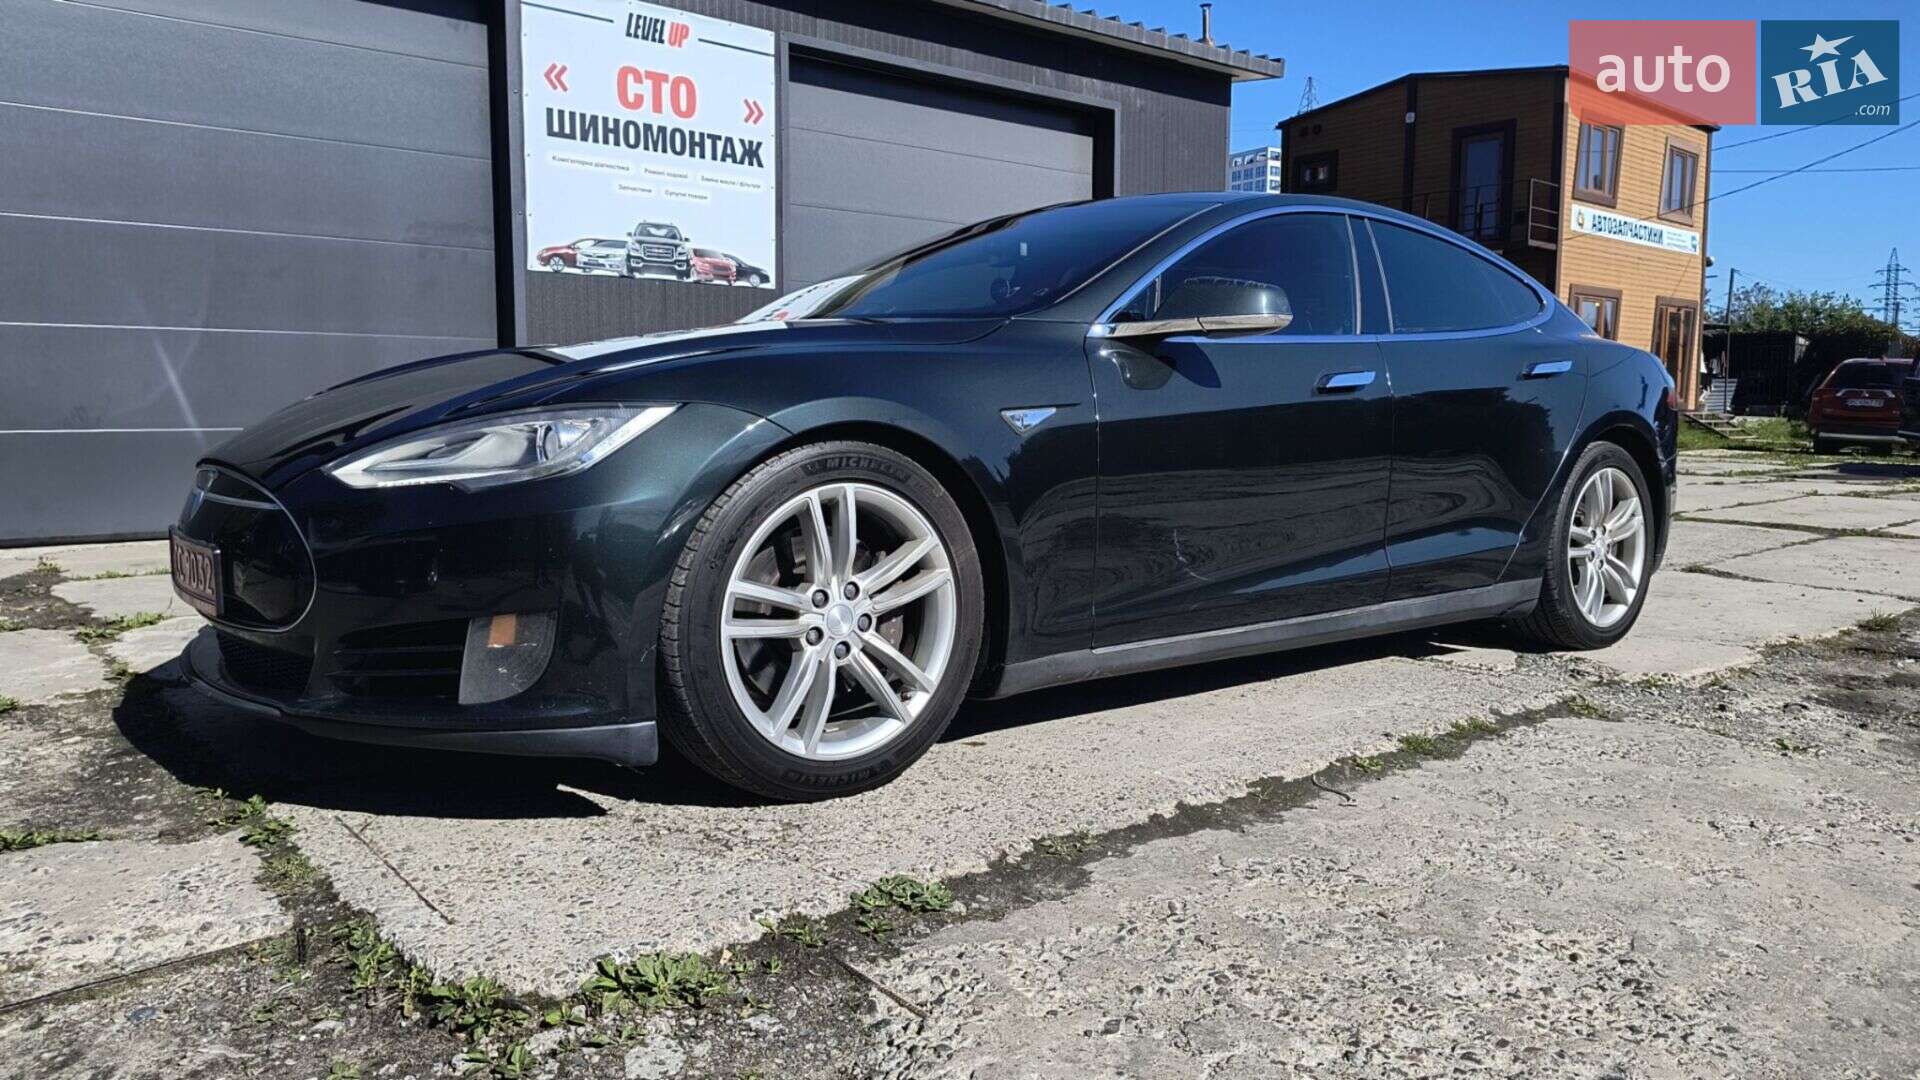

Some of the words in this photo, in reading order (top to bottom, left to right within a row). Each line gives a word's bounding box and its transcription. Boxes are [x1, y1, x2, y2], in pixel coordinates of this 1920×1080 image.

[625, 12, 666, 45] LEVEL
[667, 21, 690, 48] UP
[616, 65, 697, 120] СТО
[545, 106, 765, 169] ШИНОМОНТАЖ
[1591, 213, 1664, 246] АВТОЗАПЧАСТИНИ
[825, 456, 909, 481] MICHELIN
